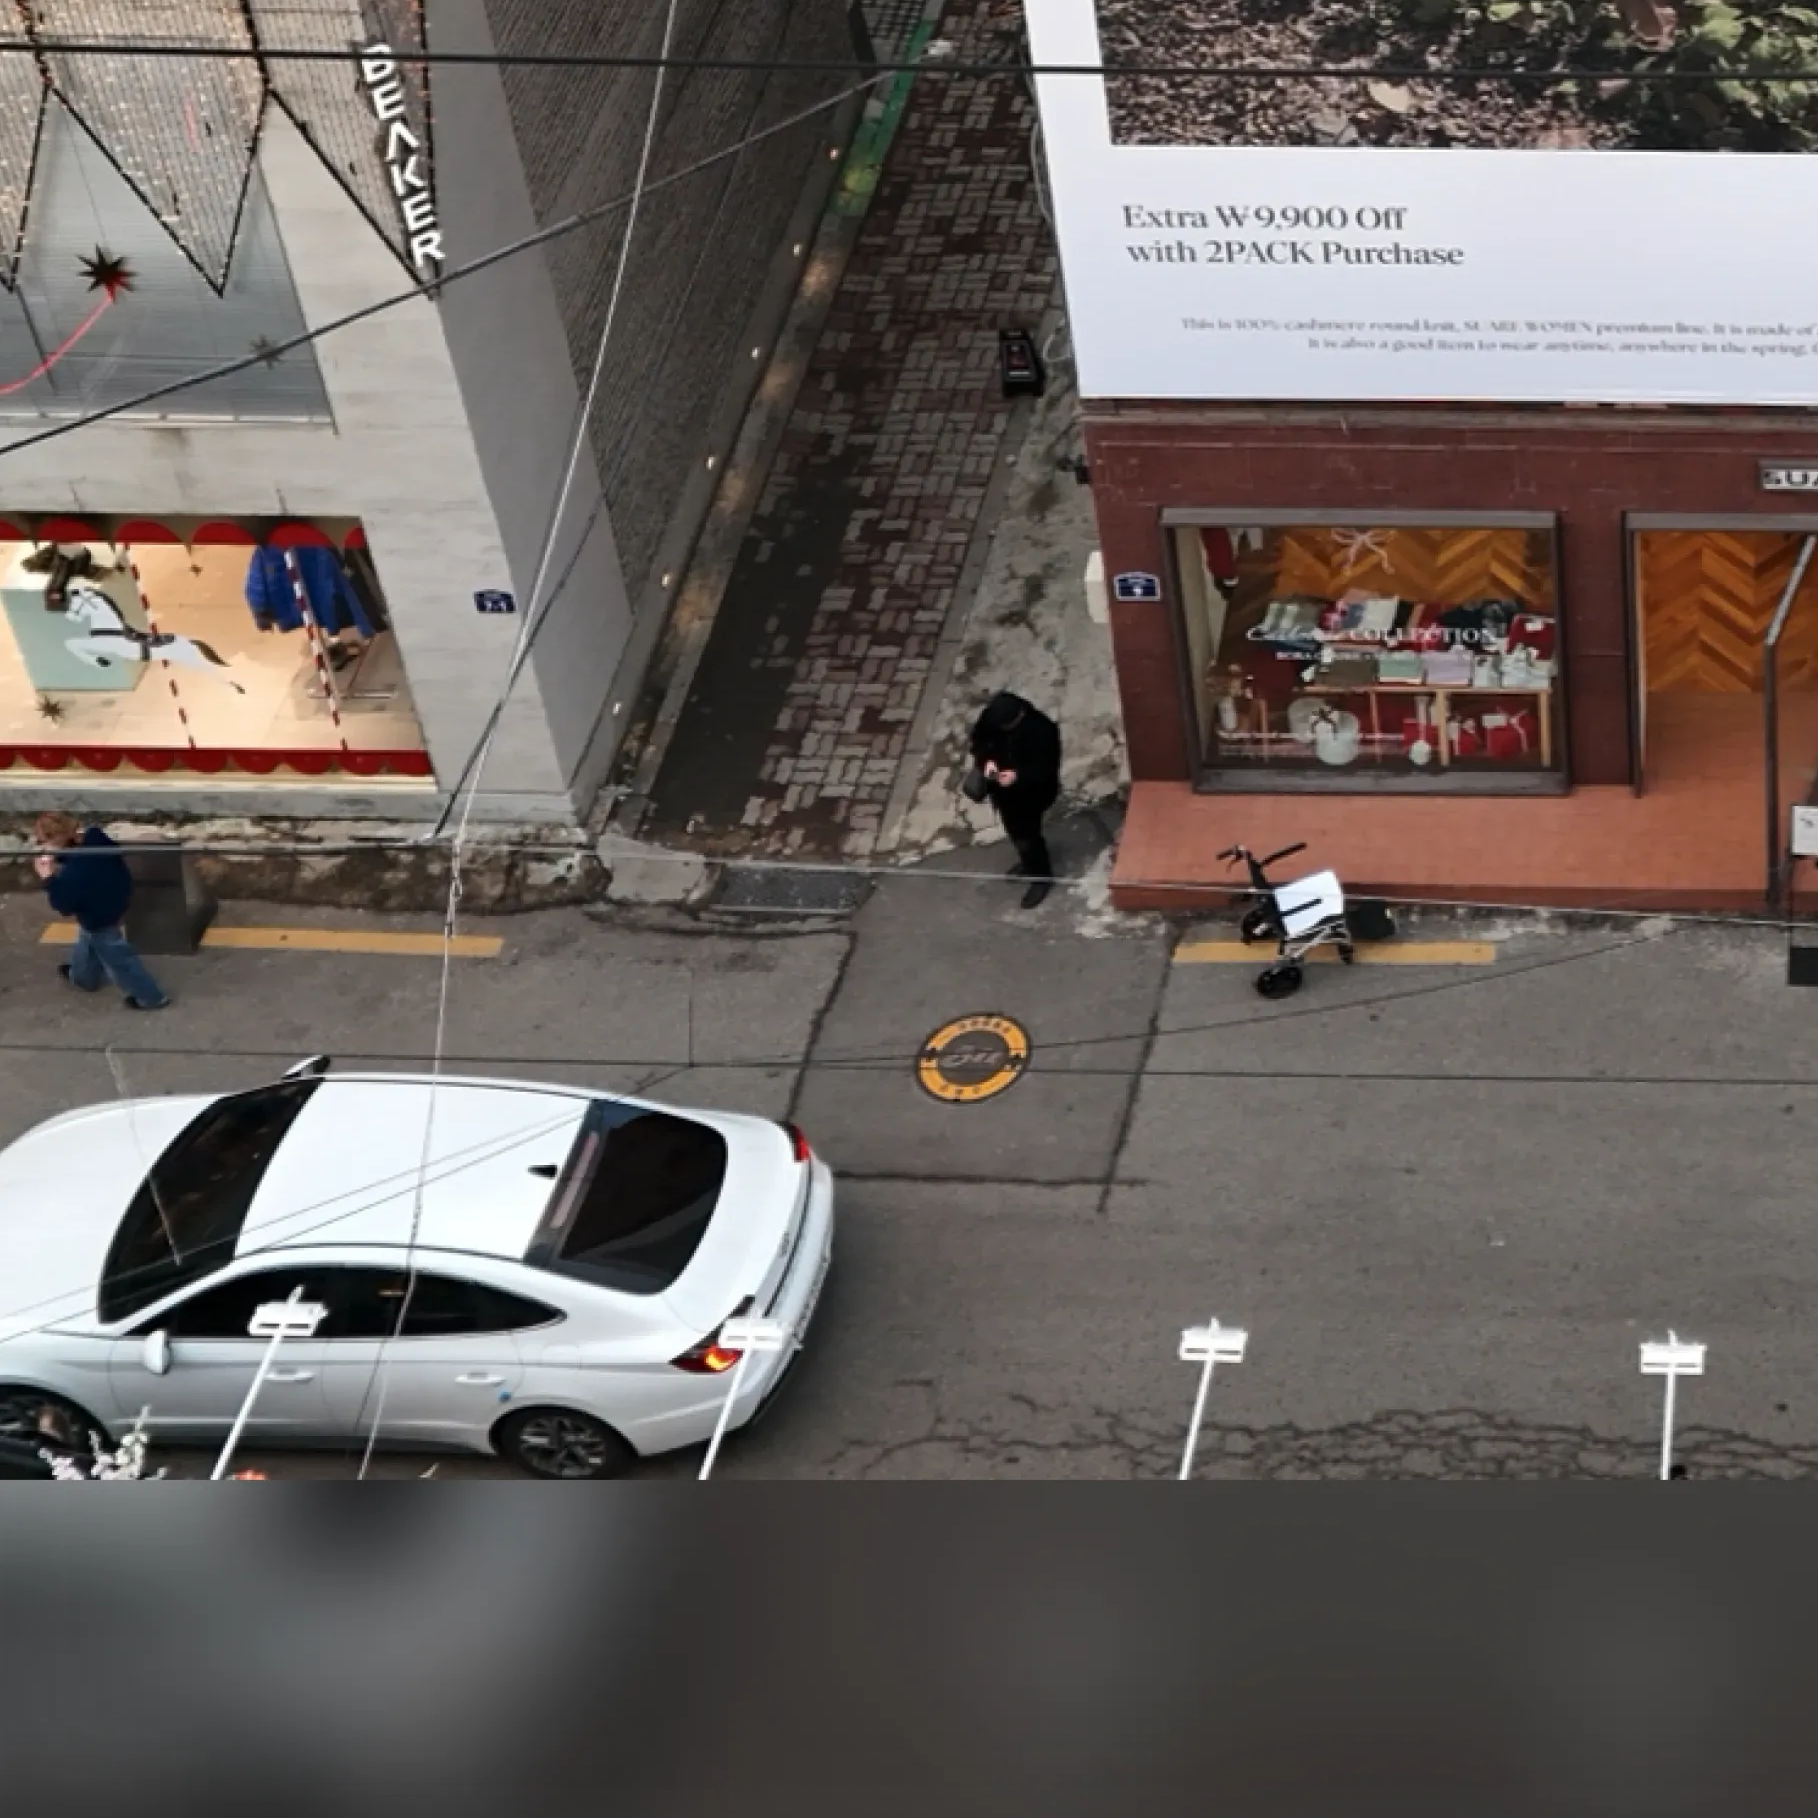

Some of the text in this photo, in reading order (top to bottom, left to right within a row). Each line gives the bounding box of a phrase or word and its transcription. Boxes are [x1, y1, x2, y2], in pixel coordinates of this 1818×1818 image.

[1122, 204, 1209, 229] Extra
[1355, 205, 1408, 231] Off
[1125, 239, 1465, 266] with 2PACK Purchase
